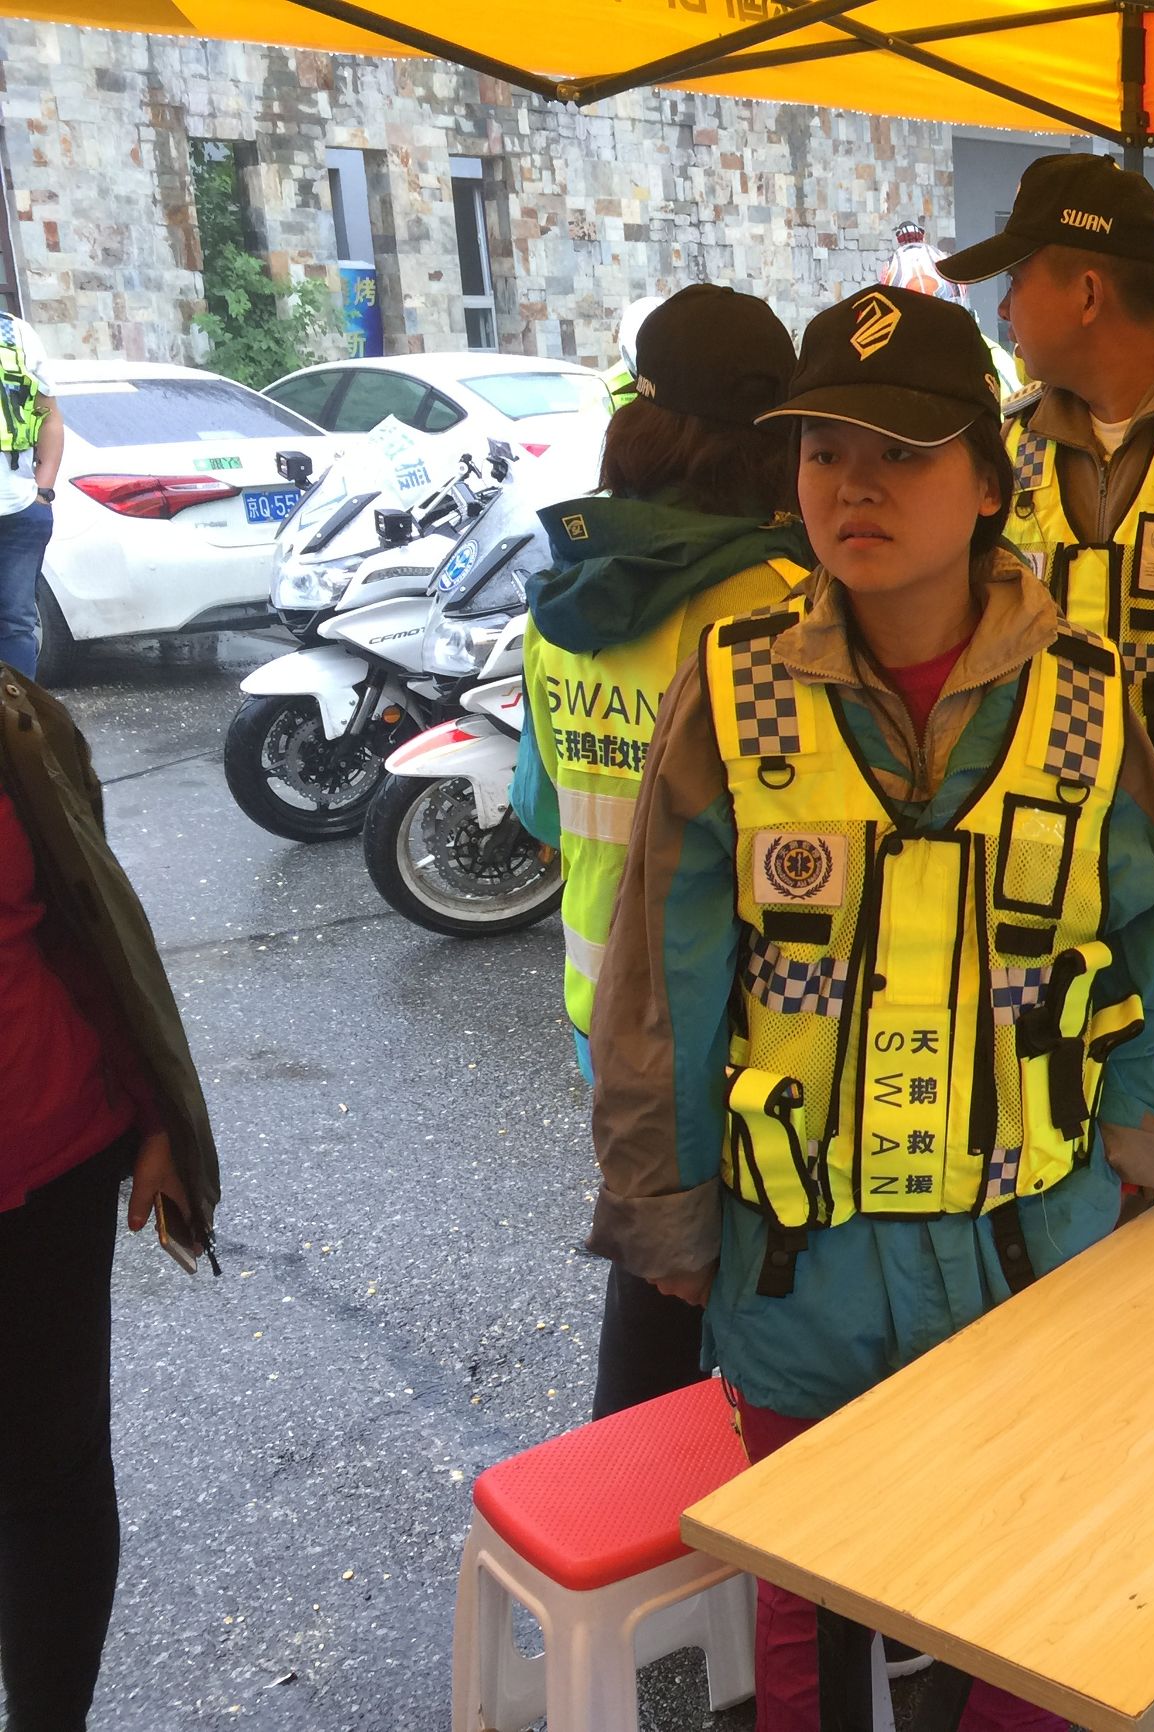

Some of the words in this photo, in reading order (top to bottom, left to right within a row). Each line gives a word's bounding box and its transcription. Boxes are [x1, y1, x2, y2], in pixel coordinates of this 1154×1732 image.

[1060, 208, 1114, 235] SWAN
[870, 1030, 905, 1195] SWAN
[905, 1029, 940, 1195] 天鹅救援
